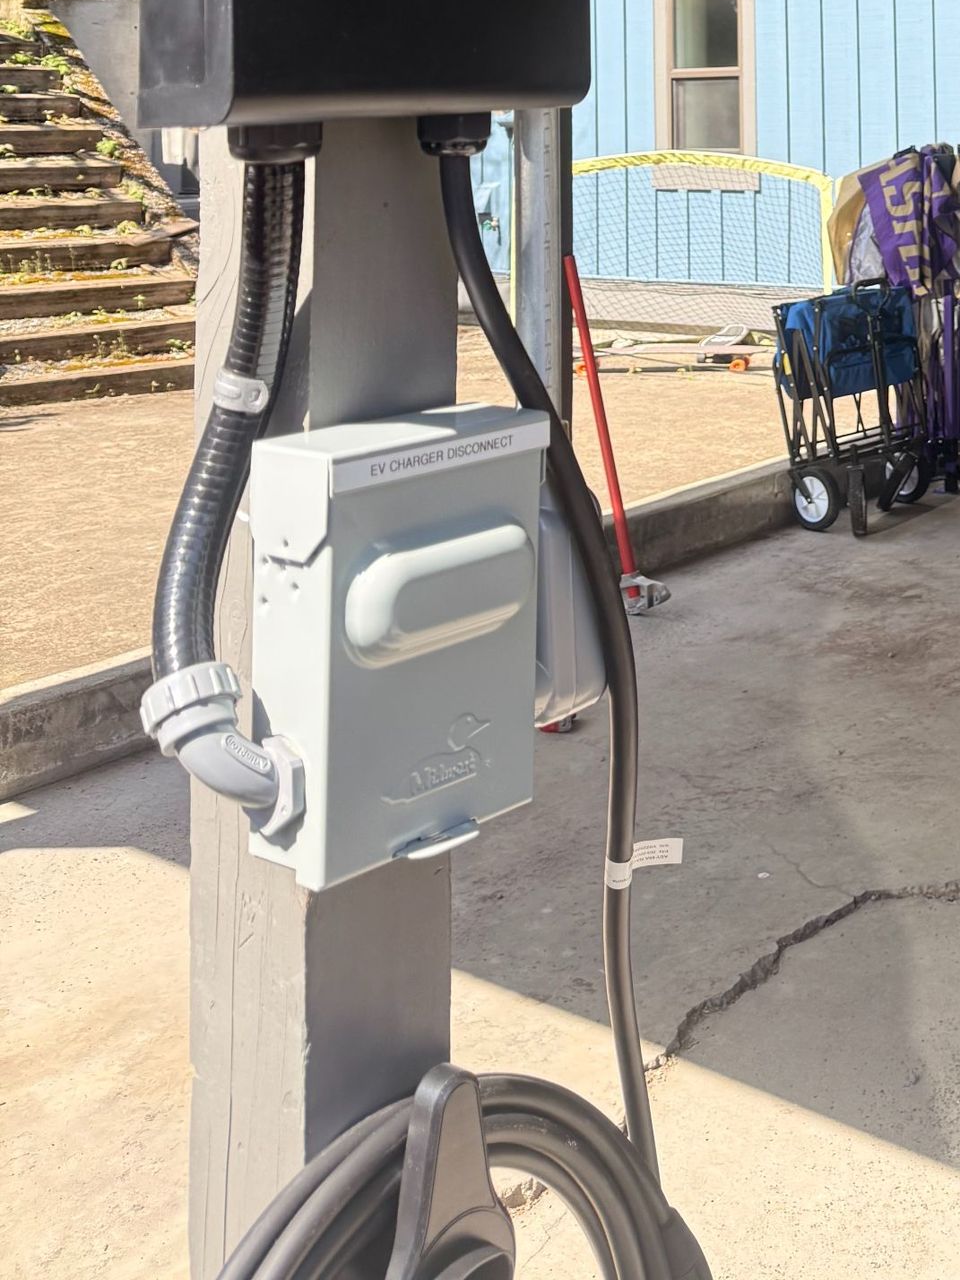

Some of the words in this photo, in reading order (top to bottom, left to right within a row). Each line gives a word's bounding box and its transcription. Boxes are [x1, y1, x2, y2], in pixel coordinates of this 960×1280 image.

[370, 463, 387, 477] EV
[389, 450, 444, 473] CHARGER
[447, 434, 514, 460] DISCONNECT
